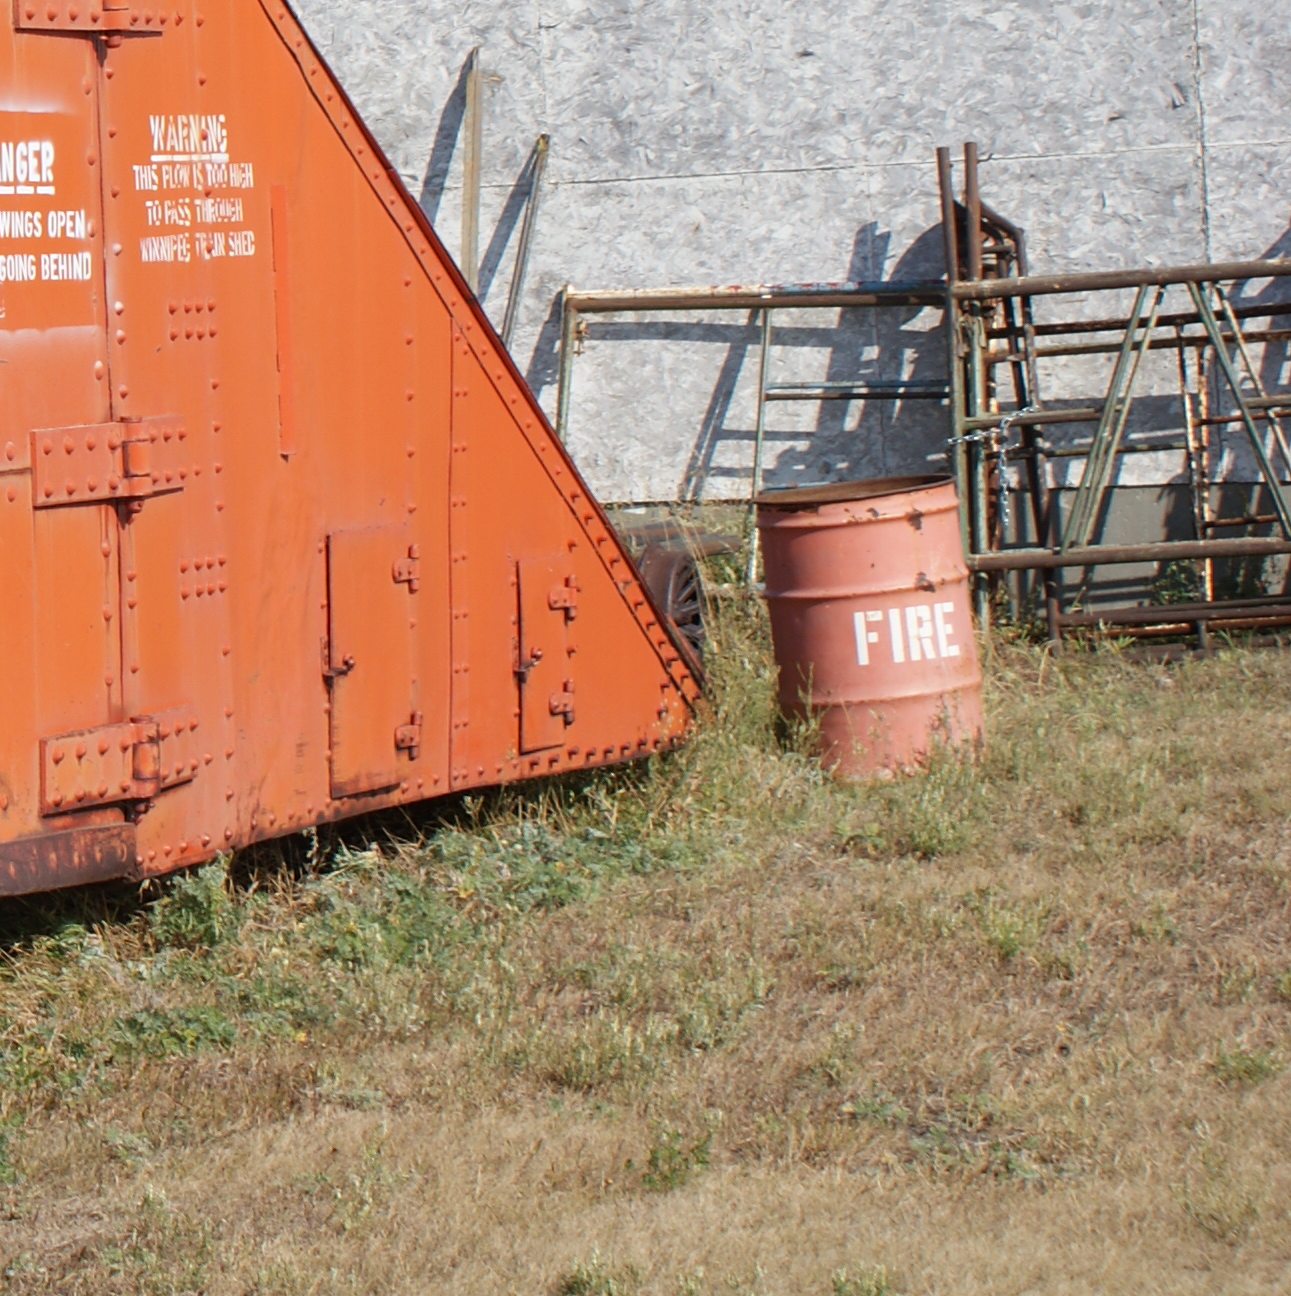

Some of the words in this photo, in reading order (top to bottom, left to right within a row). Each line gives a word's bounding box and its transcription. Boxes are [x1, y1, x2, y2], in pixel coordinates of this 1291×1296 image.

[149, 114, 228, 153] WARNING
[132, 164, 159, 191] THIS
[162, 164, 190, 189] PLOW
[192, 162, 204, 191] IS
[206, 163, 228, 189] TOO
[229, 163, 254, 188] HIGH
[48, 209, 85, 239] OPEN
[145, 200, 162, 226] TO
[163, 197, 191, 226] PASS
[194, 198, 243, 223] THROUGH
[139, 232, 191, 262] WINNIPEG
[228, 230, 255, 257] SHED
[41, 252, 92, 280] BEHIND
[853, 601, 960, 666] FIRE
